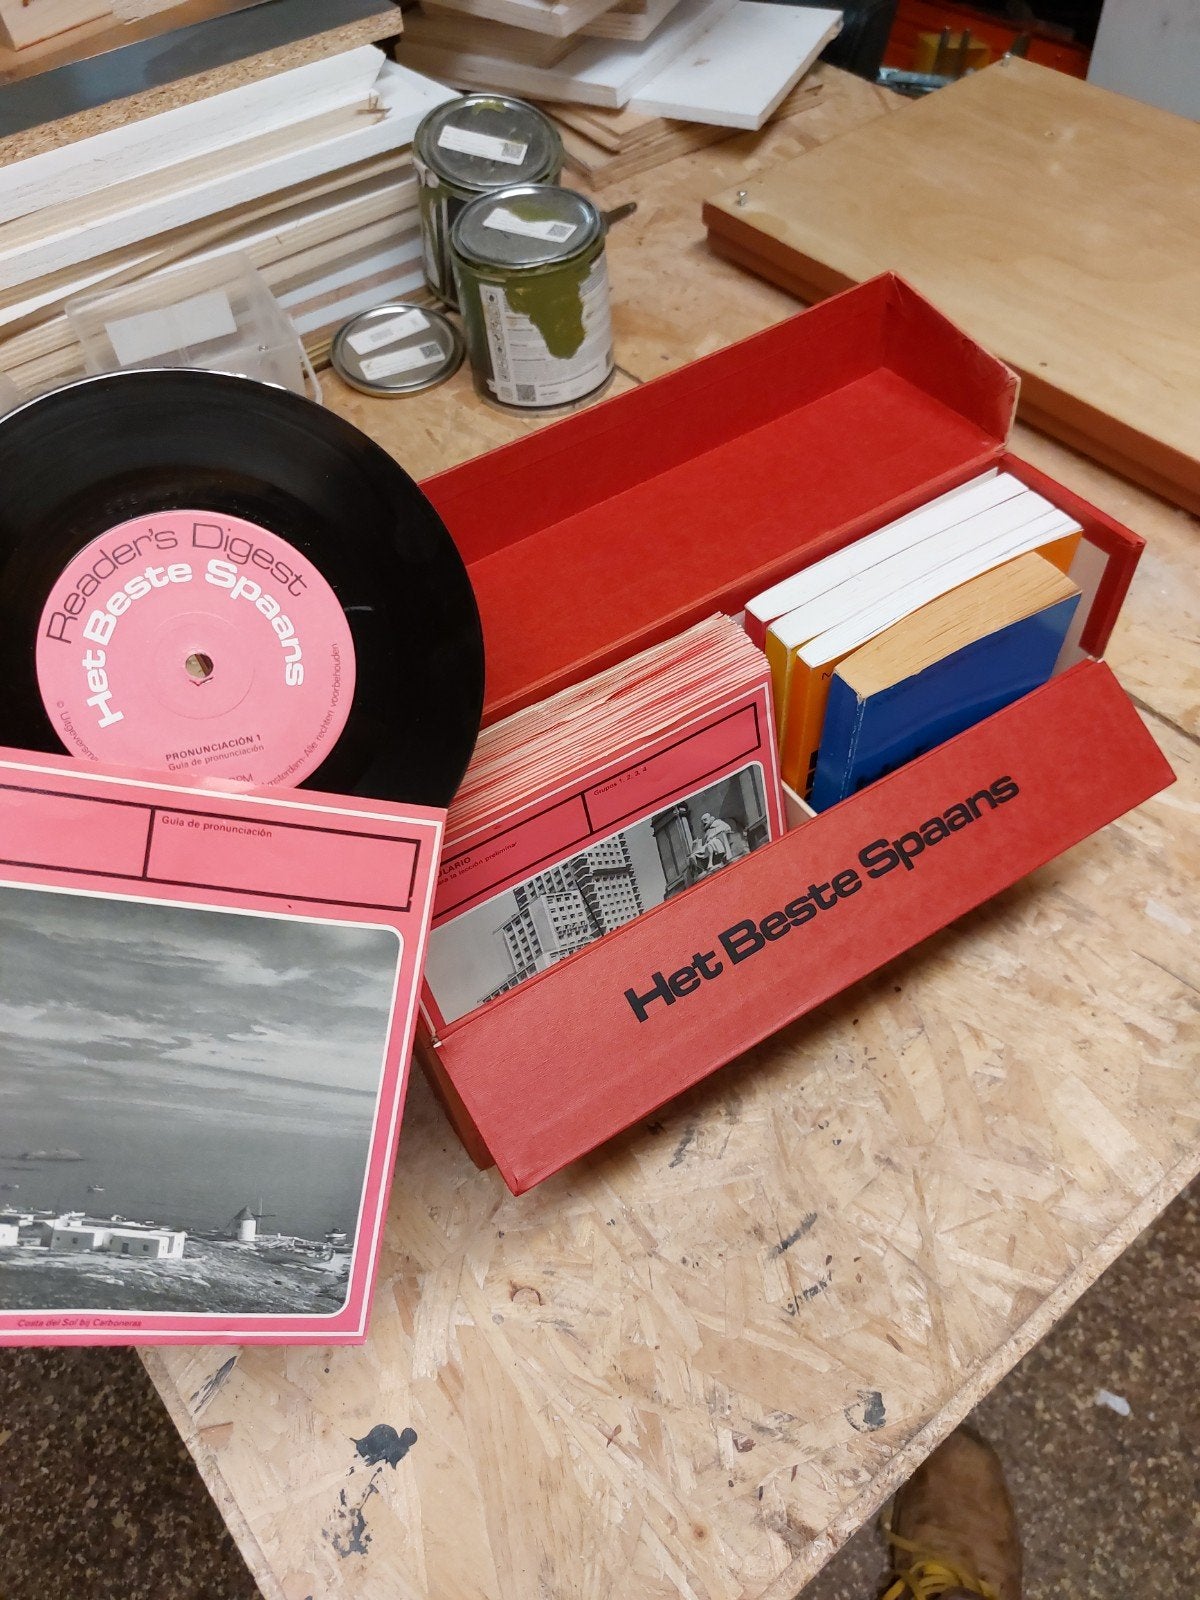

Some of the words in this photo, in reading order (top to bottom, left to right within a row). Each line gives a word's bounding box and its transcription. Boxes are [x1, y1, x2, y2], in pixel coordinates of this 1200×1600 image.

[46, 528, 178, 644] Reader's
[192, 523, 308, 597] Digest
[82, 563, 192, 645] Beste
[204, 559, 304, 686] Spaans
[82, 649, 124, 728] Het
[165, 736, 254, 761] PRONUNCIACIÓN
[191, 757, 202, 767] de
[204, 744, 265, 764] pronunciación
[593, 783, 617, 796] Grupos
[187, 819, 200, 828] de
[203, 823, 272, 838] pronunciación
[623, 949, 723, 1023] Het
[718, 868, 863, 965] Beste
[858, 774, 1020, 880] Spaans
[17, 1319, 43, 1328] Costa
[46, 1318, 61, 1327] del
[62, 1318, 78, 1327] Sol
